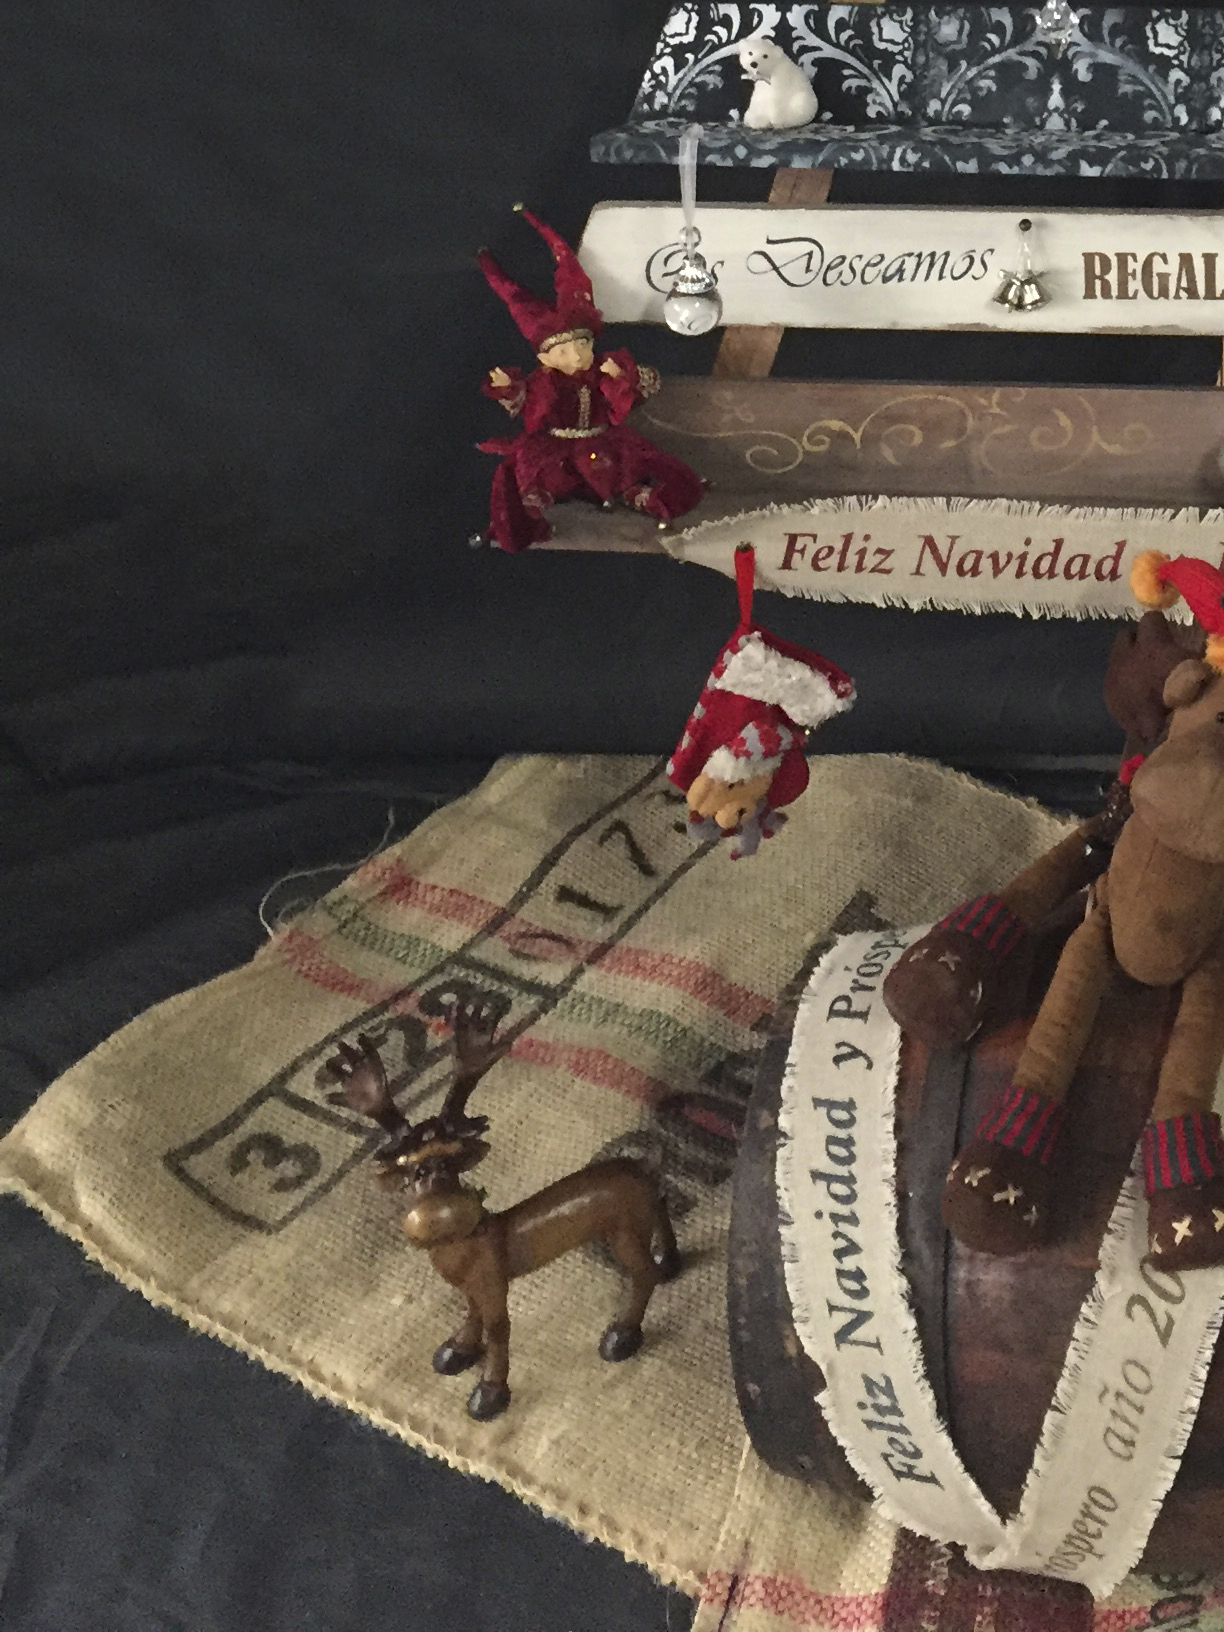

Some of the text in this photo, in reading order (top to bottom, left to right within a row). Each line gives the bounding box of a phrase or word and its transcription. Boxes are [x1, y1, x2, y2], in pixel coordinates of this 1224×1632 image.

[746, 235, 996, 289] Deseamos
[777, 531, 896, 577] Feliz
[910, 533, 1127, 584] Navidad
[832, 1040, 874, 1072] y
[822, 1095, 883, 1355] Navidad
[857, 1373, 945, 1490] Feliz
[1100, 1356, 1156, 1464] año
